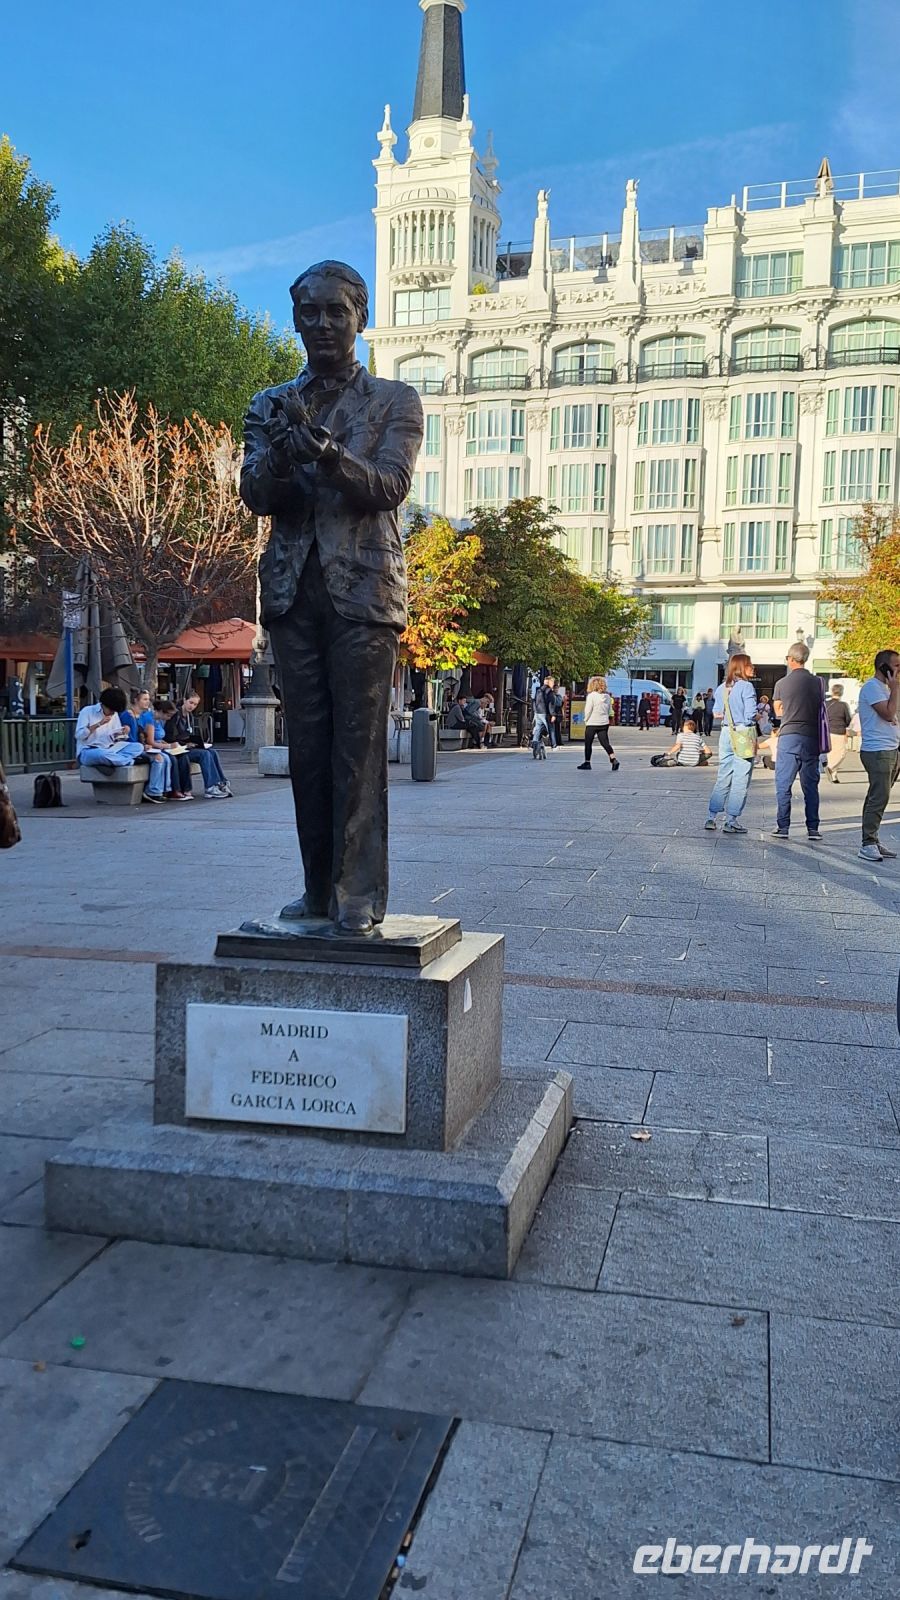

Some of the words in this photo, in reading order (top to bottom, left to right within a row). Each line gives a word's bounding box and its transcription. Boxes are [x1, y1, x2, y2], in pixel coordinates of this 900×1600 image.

[261, 1022, 329, 1040] MADRID
[288, 1048, 300, 1063] A
[251, 1070, 337, 1090] FEDERICO
[231, 1093, 296, 1111] GARCIA
[301, 1097, 357, 1116] LORCA
